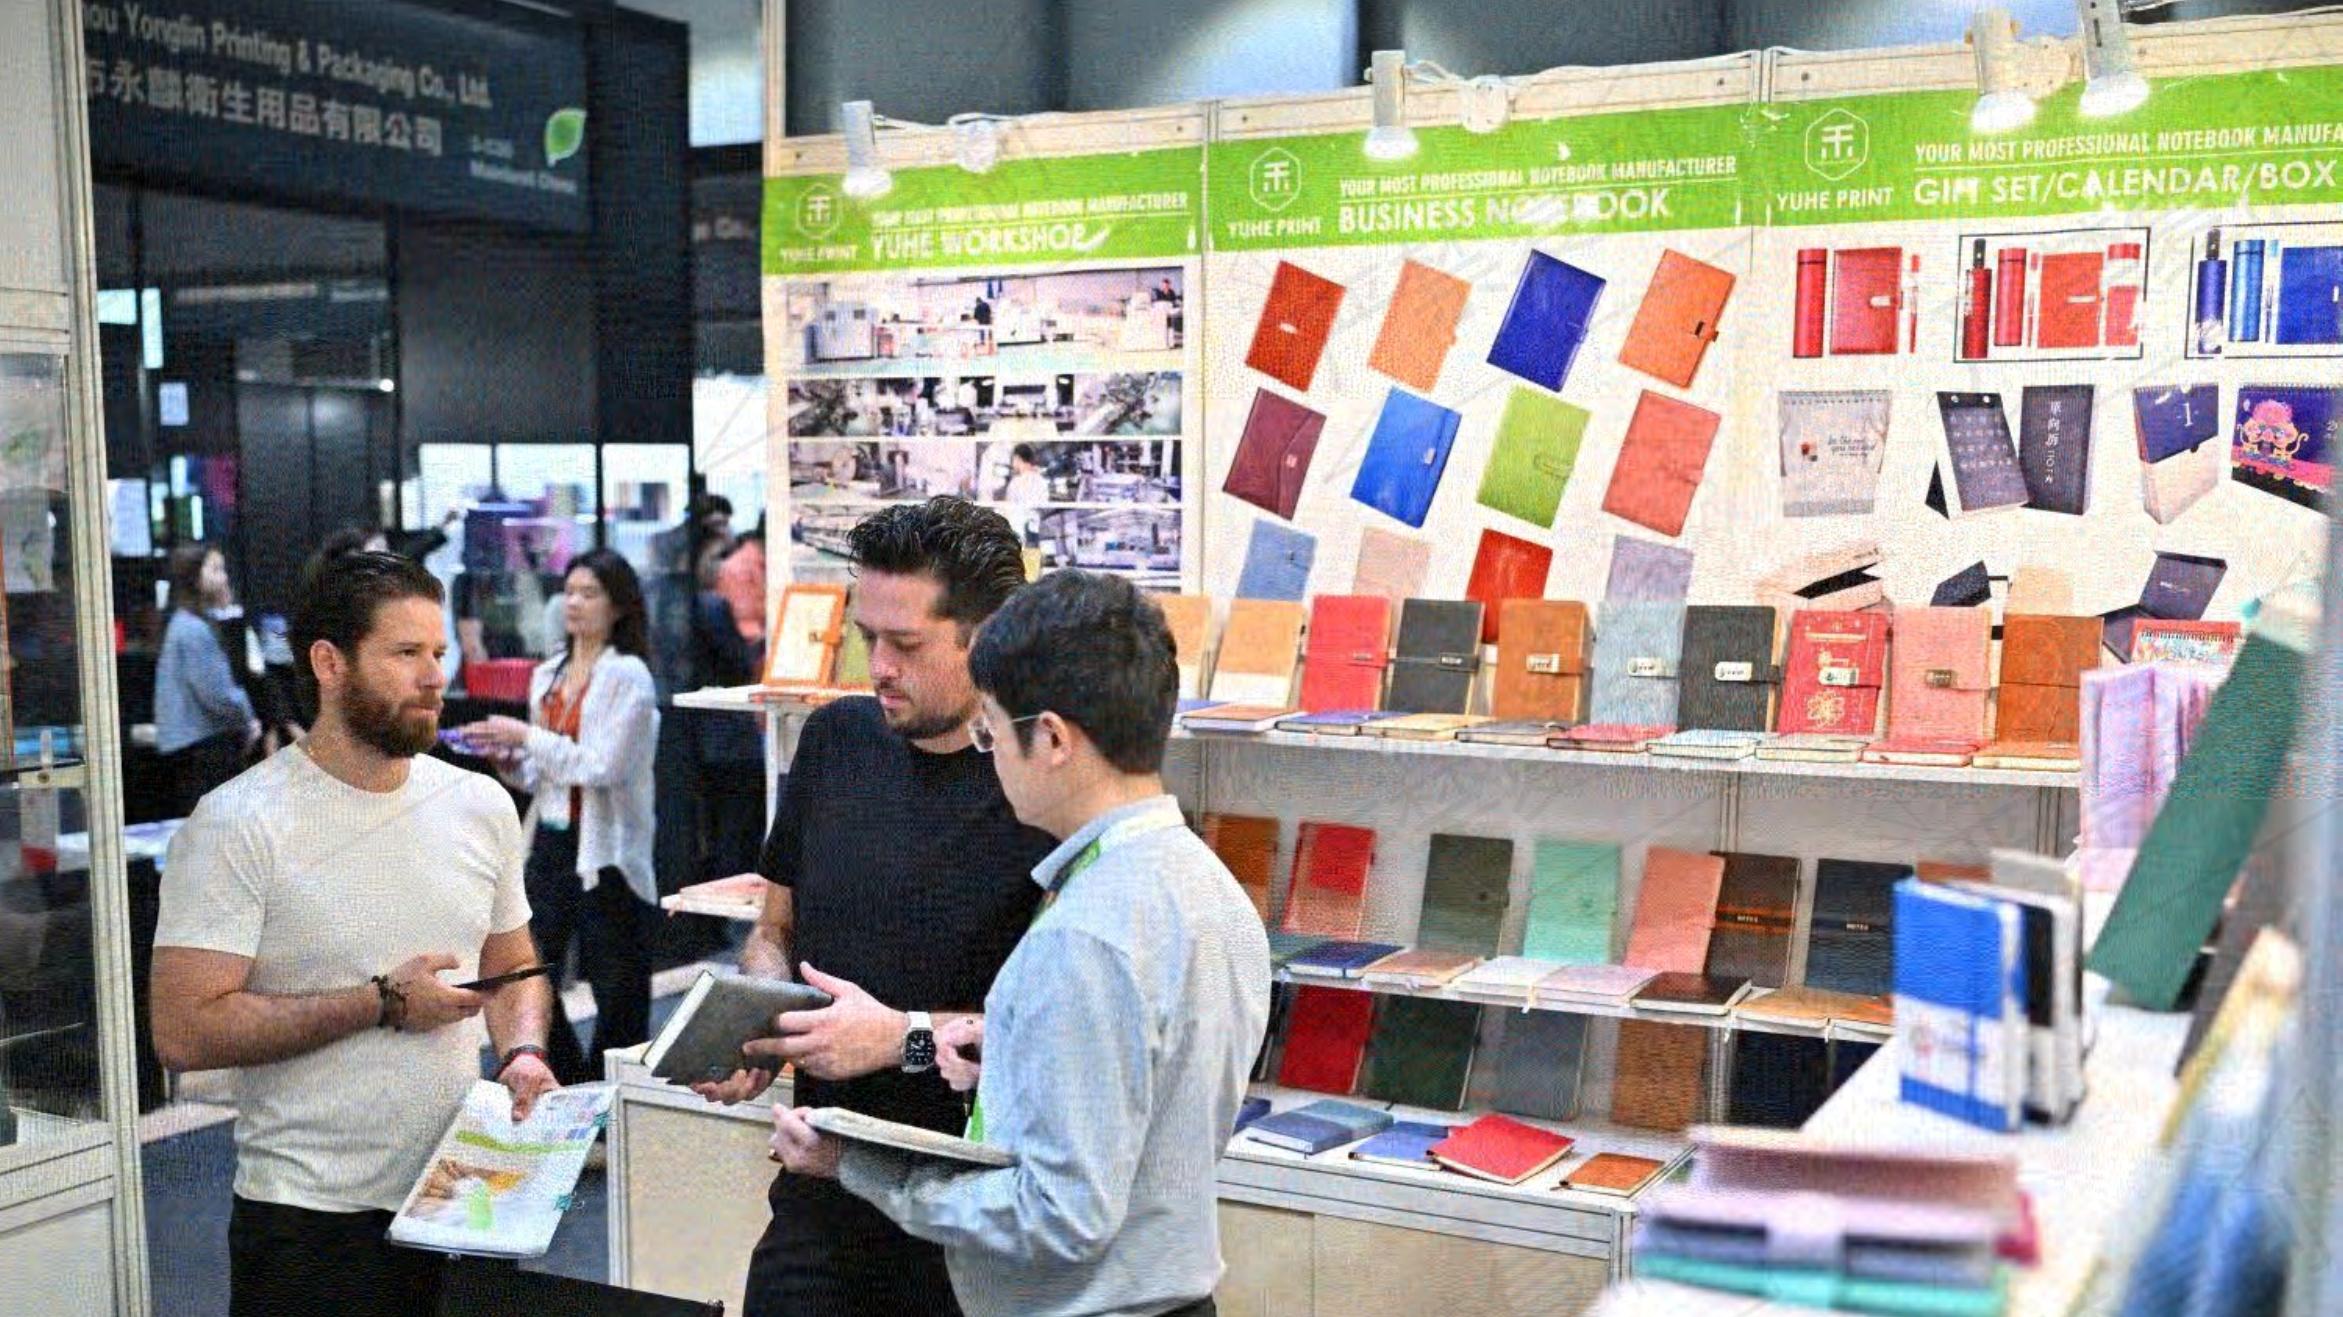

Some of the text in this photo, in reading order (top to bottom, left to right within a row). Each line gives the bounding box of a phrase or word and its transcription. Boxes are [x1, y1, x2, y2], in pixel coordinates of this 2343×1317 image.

[212, 20, 291, 75] Printing
[298, 39, 311, 73] &
[317, 44, 416, 100] Packaging
[1915, 142, 1962, 163] YOUR
[1968, 139, 2017, 162] MOST
[2022, 131, 2150, 159] PROFESSIONAL
[2157, 127, 2257, 152] NOTEBOOK
[1340, 155, 1737, 197] YOUR MOST PROFESSIONAL NOTEBOOK MANUFACTURER
[1914, 159, 2338, 206] GIFT SET/CALENDAR/BOX
[1339, 198, 1475, 234] BUSINESS
[1777, 187, 1894, 212] YUHE PRINT
[1227, 216, 1321, 239] YUHE PRINT
[873, 231, 933, 262] YUHE
